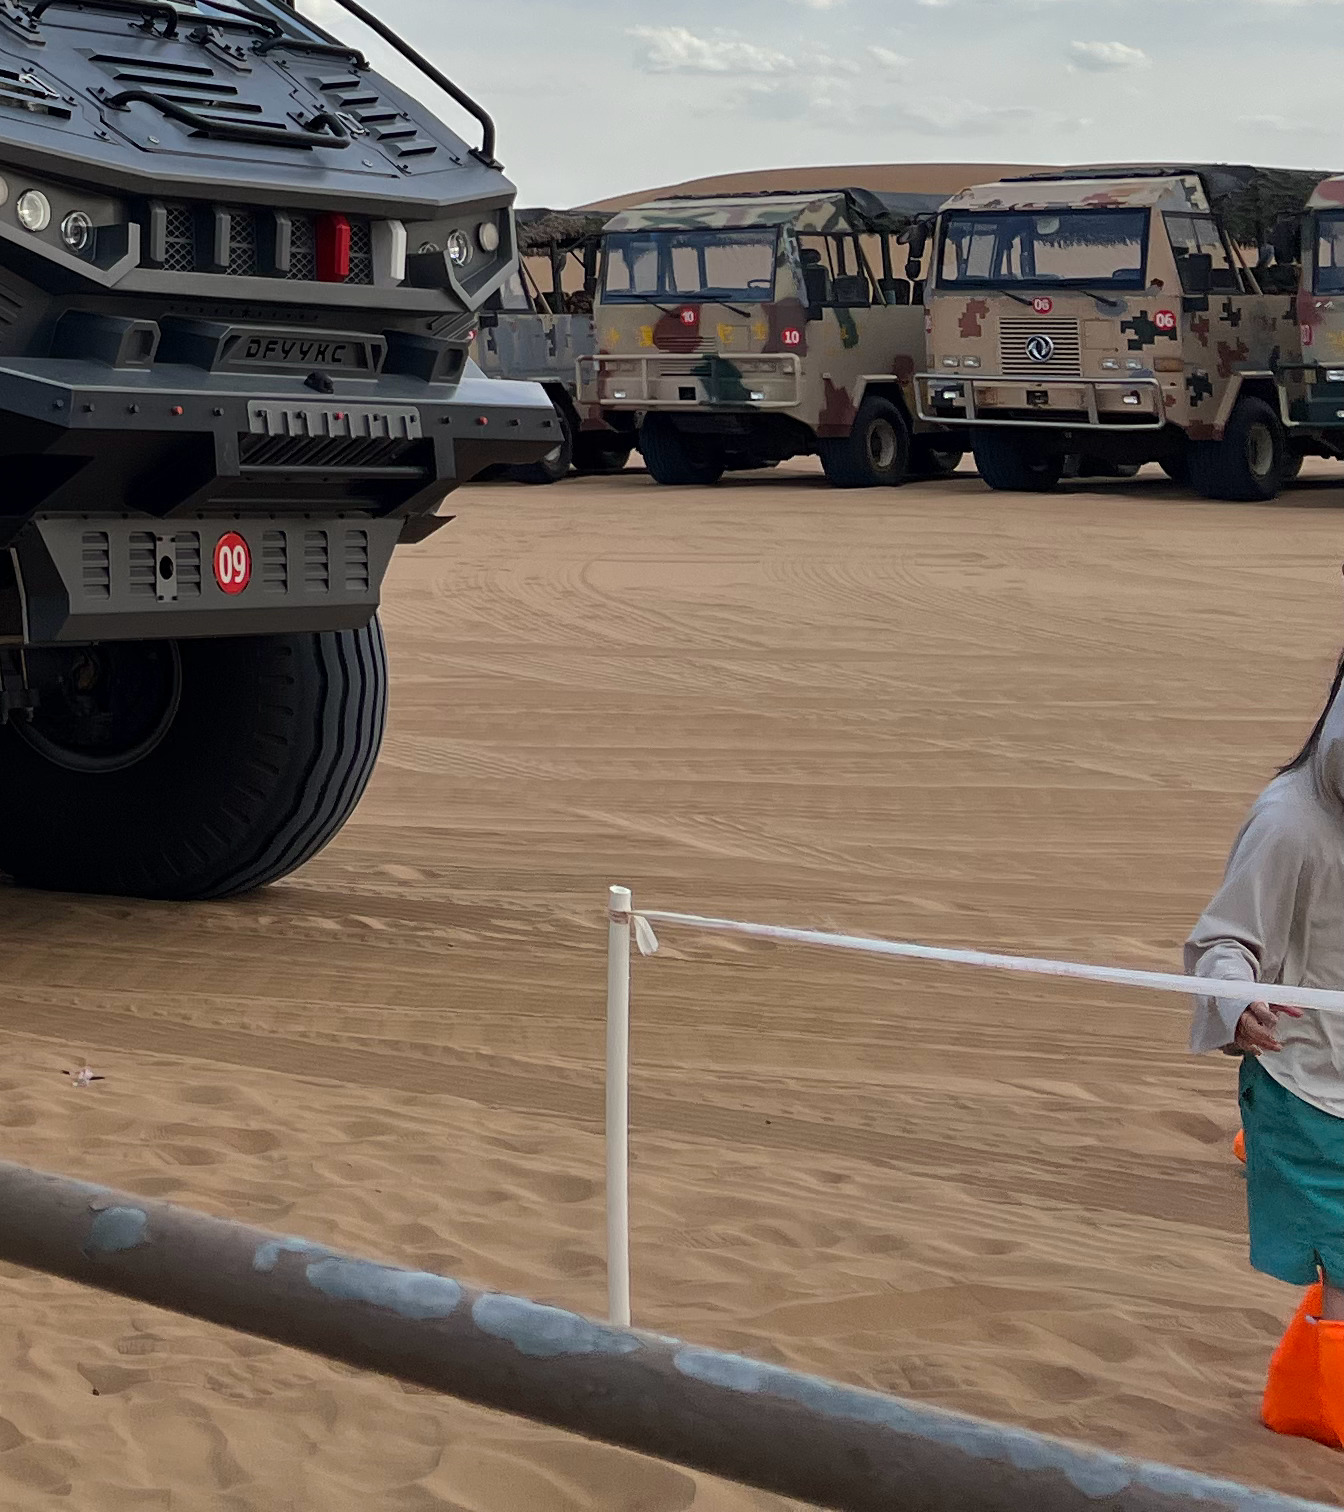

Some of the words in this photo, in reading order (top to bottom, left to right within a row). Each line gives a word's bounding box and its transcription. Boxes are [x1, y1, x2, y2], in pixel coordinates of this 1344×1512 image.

[1156, 314, 1174, 328] 06
[784, 332, 800, 344] 10
[219, 545, 246, 584] 09
